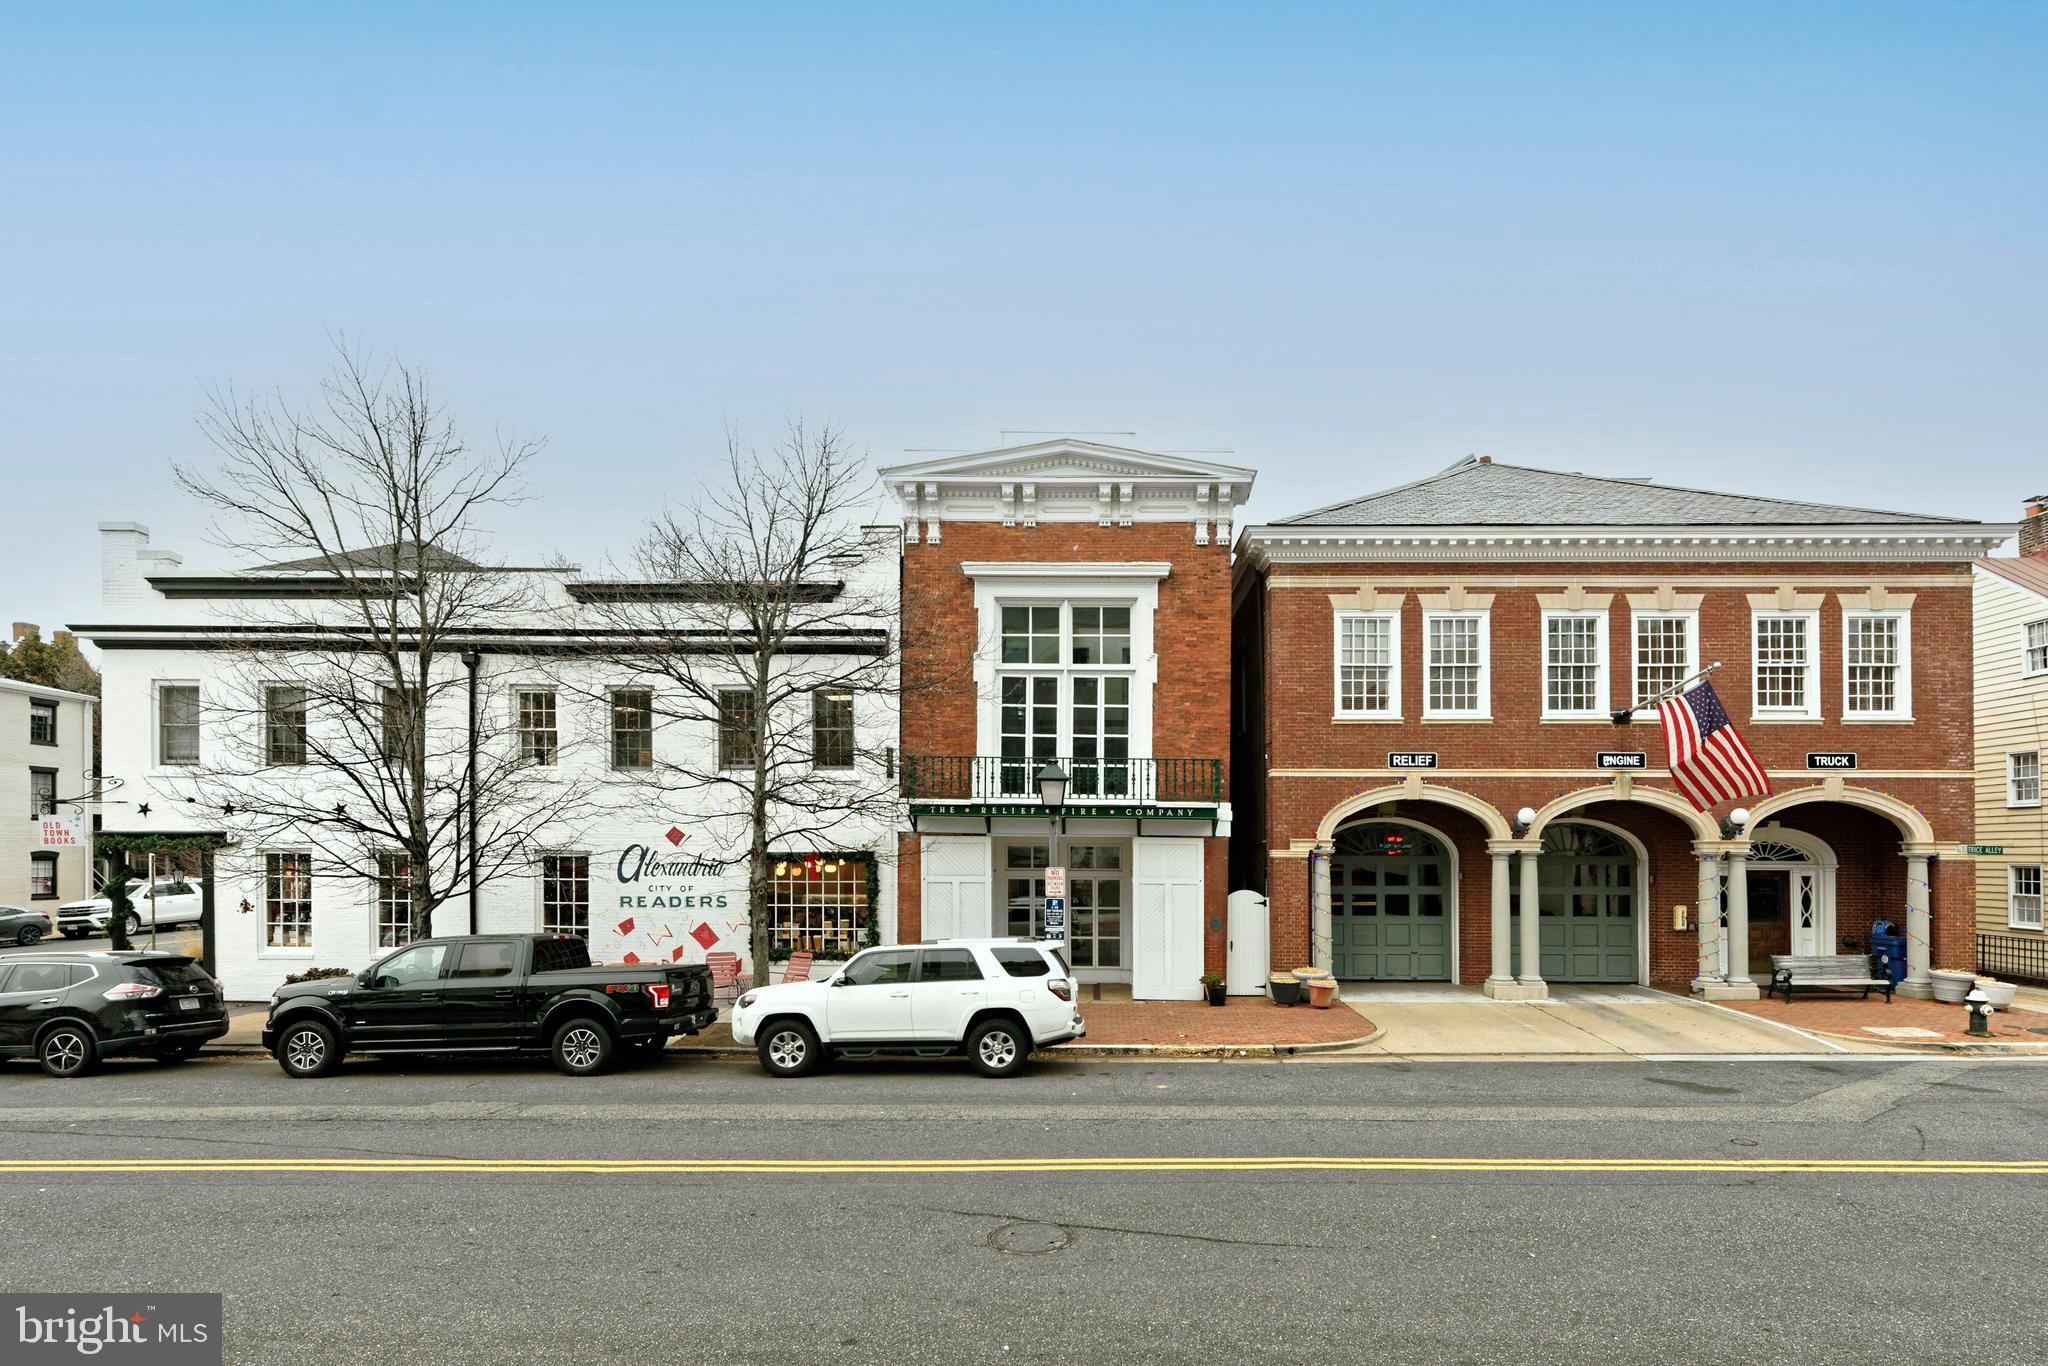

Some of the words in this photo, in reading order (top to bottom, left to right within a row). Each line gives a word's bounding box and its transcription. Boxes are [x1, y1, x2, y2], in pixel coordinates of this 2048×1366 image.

[1393, 755, 1433, 766] RELIEF
[1603, 755, 1641, 766] ENGINE
[1814, 756, 1849, 766] TRUCK
[931, 806, 955, 814] THE
[981, 806, 1036, 815] RELIEF
[1061, 808, 1097, 816] FIRE
[1126, 808, 1193, 816] COMPANY
[44, 837, 76, 845] BOOKS
[617, 844, 726, 884] Alexandria
[648, 885, 672, 893] CITY
[680, 885, 694, 893] OF
[620, 896, 728, 908] READERS
